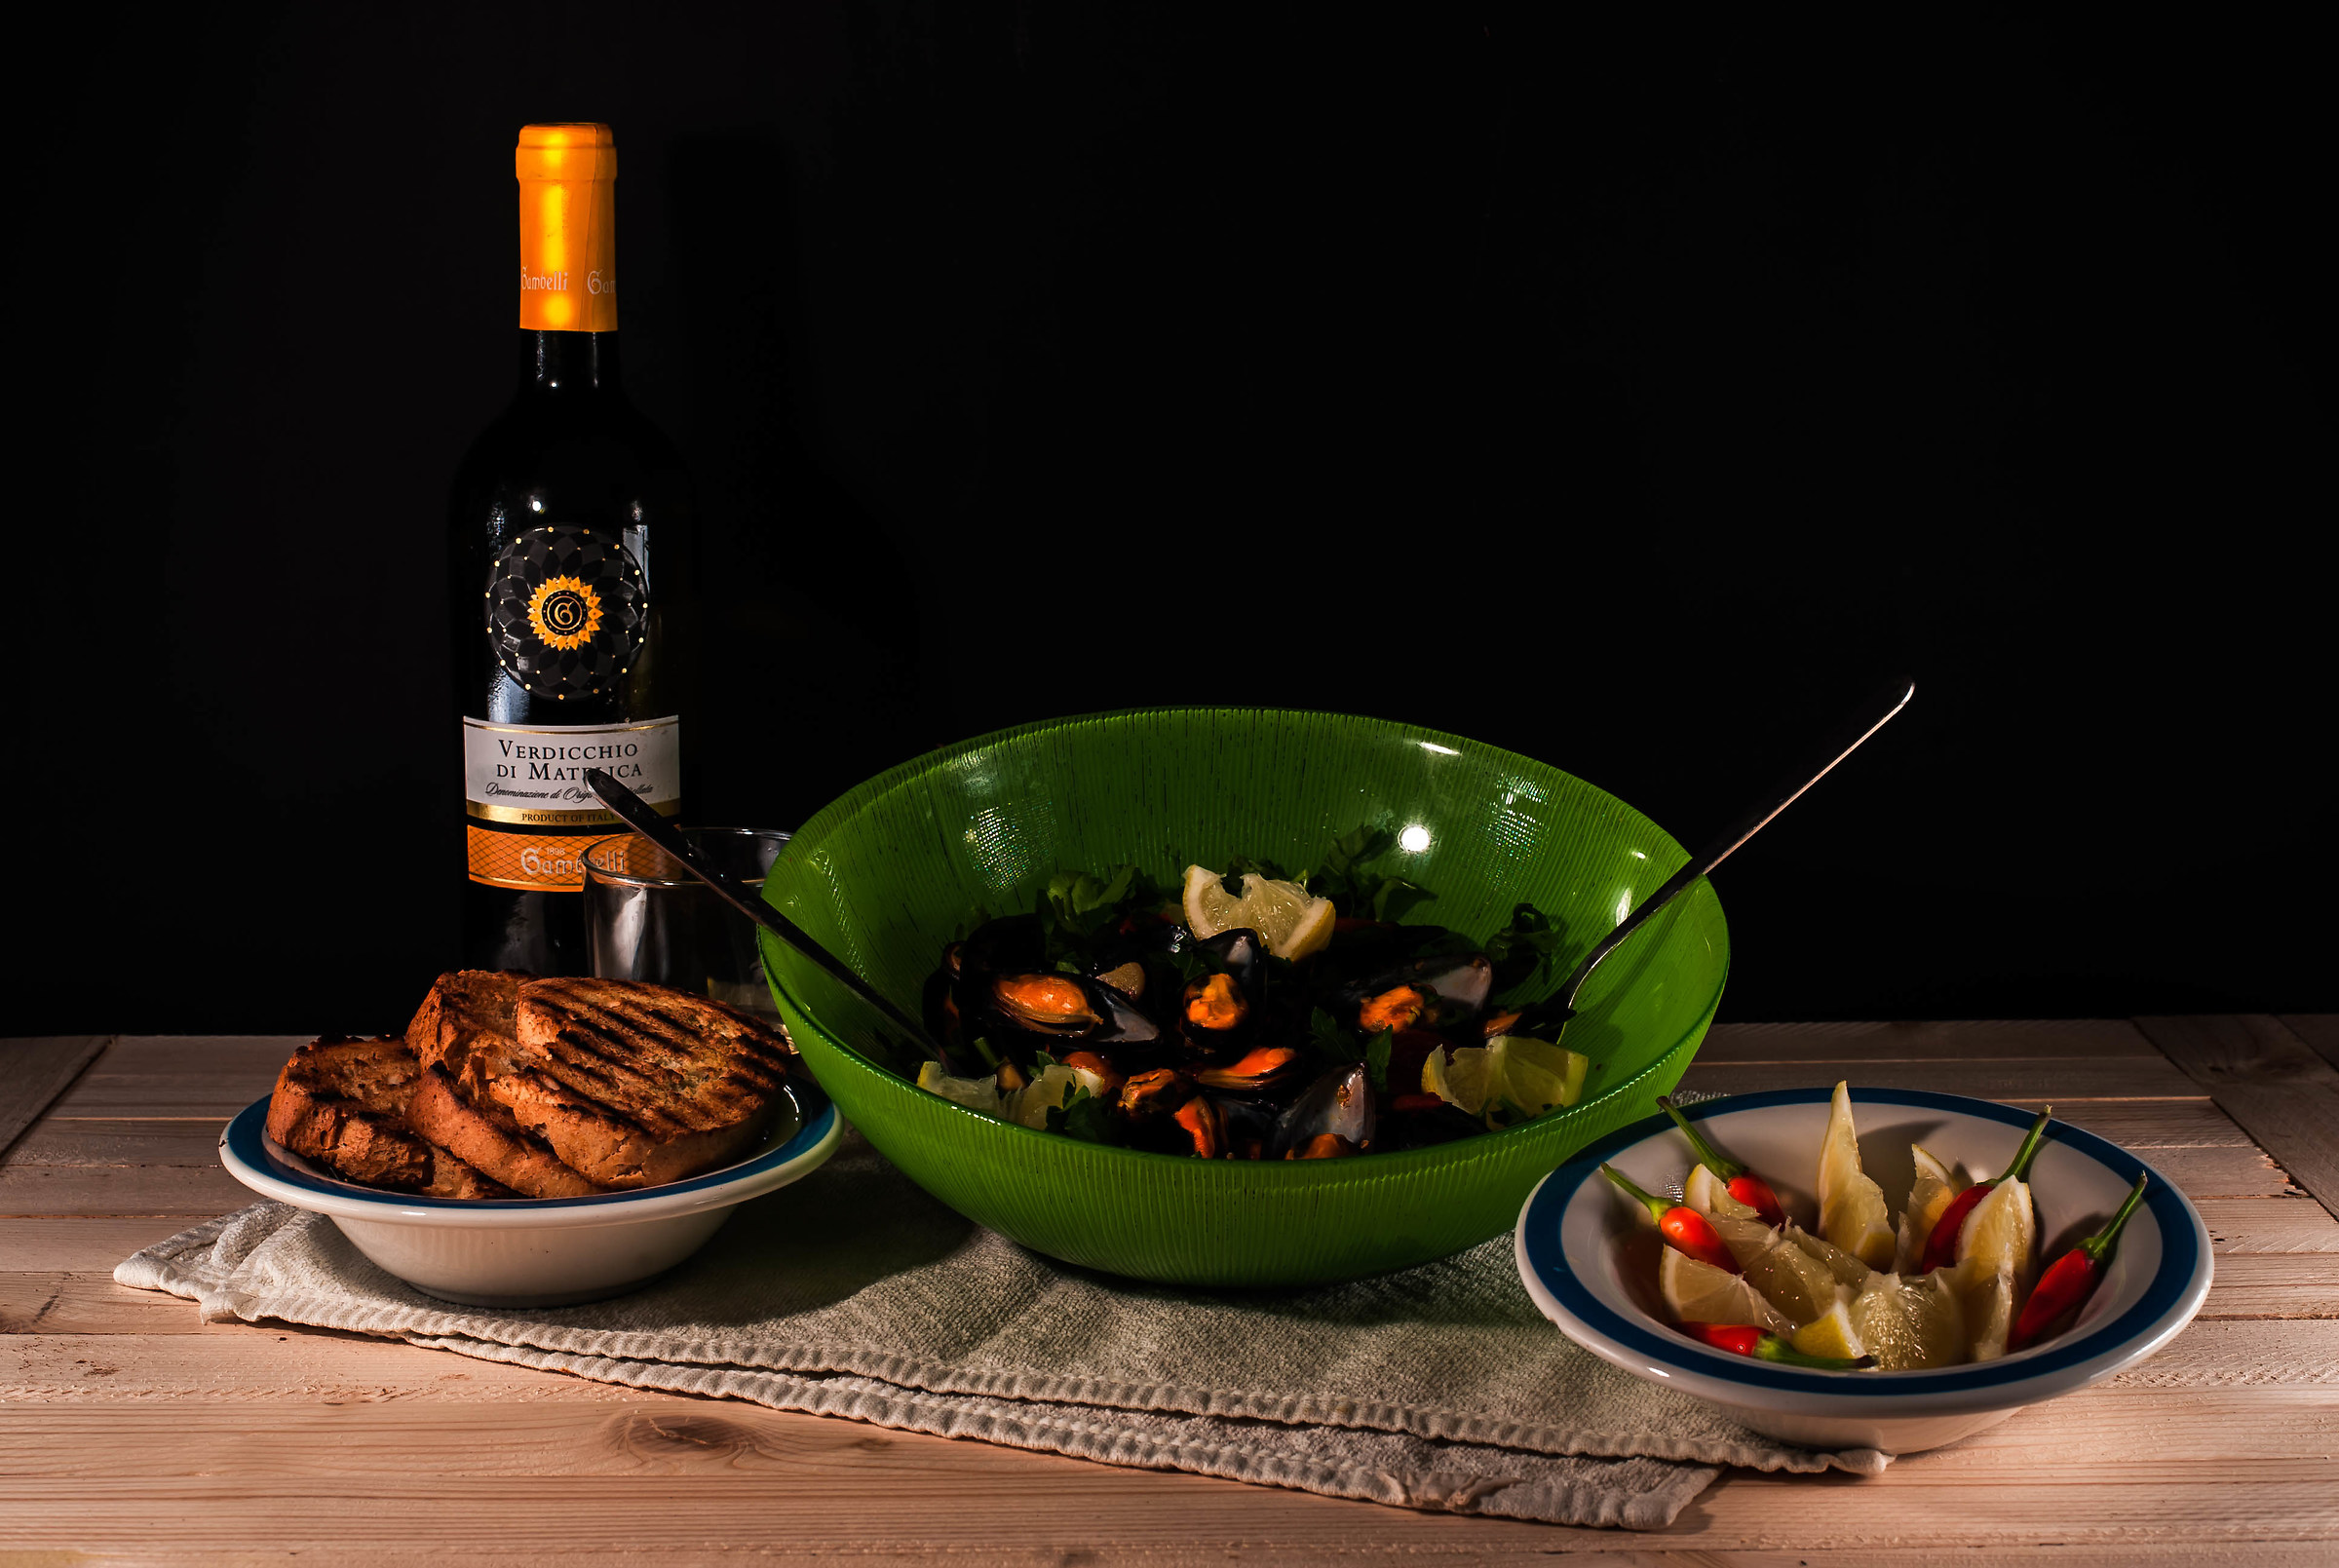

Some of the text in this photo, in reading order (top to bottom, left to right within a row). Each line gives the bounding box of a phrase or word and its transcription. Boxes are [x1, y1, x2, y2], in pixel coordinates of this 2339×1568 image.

[498, 739, 638, 760] VERDICCHIO
[496, 762, 643, 781] DI MATICA
[484, 782, 550, 799] Denominazione
[550, 788, 560, 799] di
[521, 813, 616, 822] PRODUCT OF ITALY
[546, 847, 565, 856] 1898
